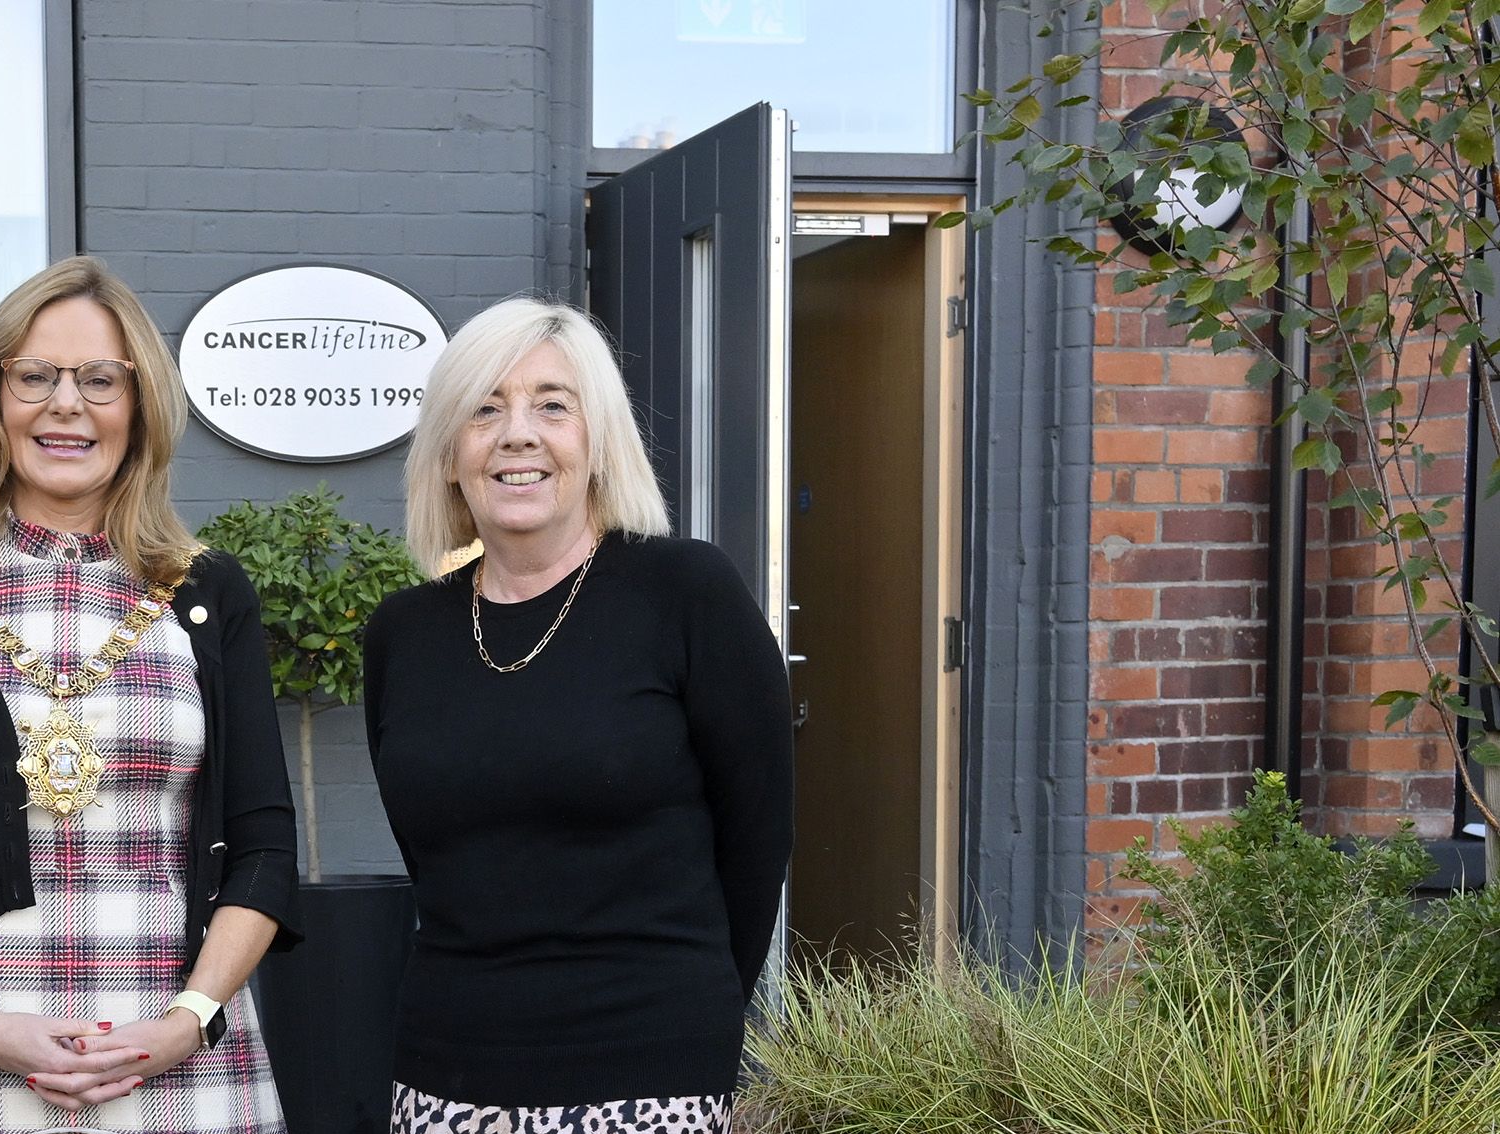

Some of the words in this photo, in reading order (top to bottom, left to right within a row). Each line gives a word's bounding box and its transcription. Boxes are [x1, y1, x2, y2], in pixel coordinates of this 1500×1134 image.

[206, 387, 246, 406] Tel:
[253, 387, 297, 406] 028
[304, 387, 361, 406] 9035
